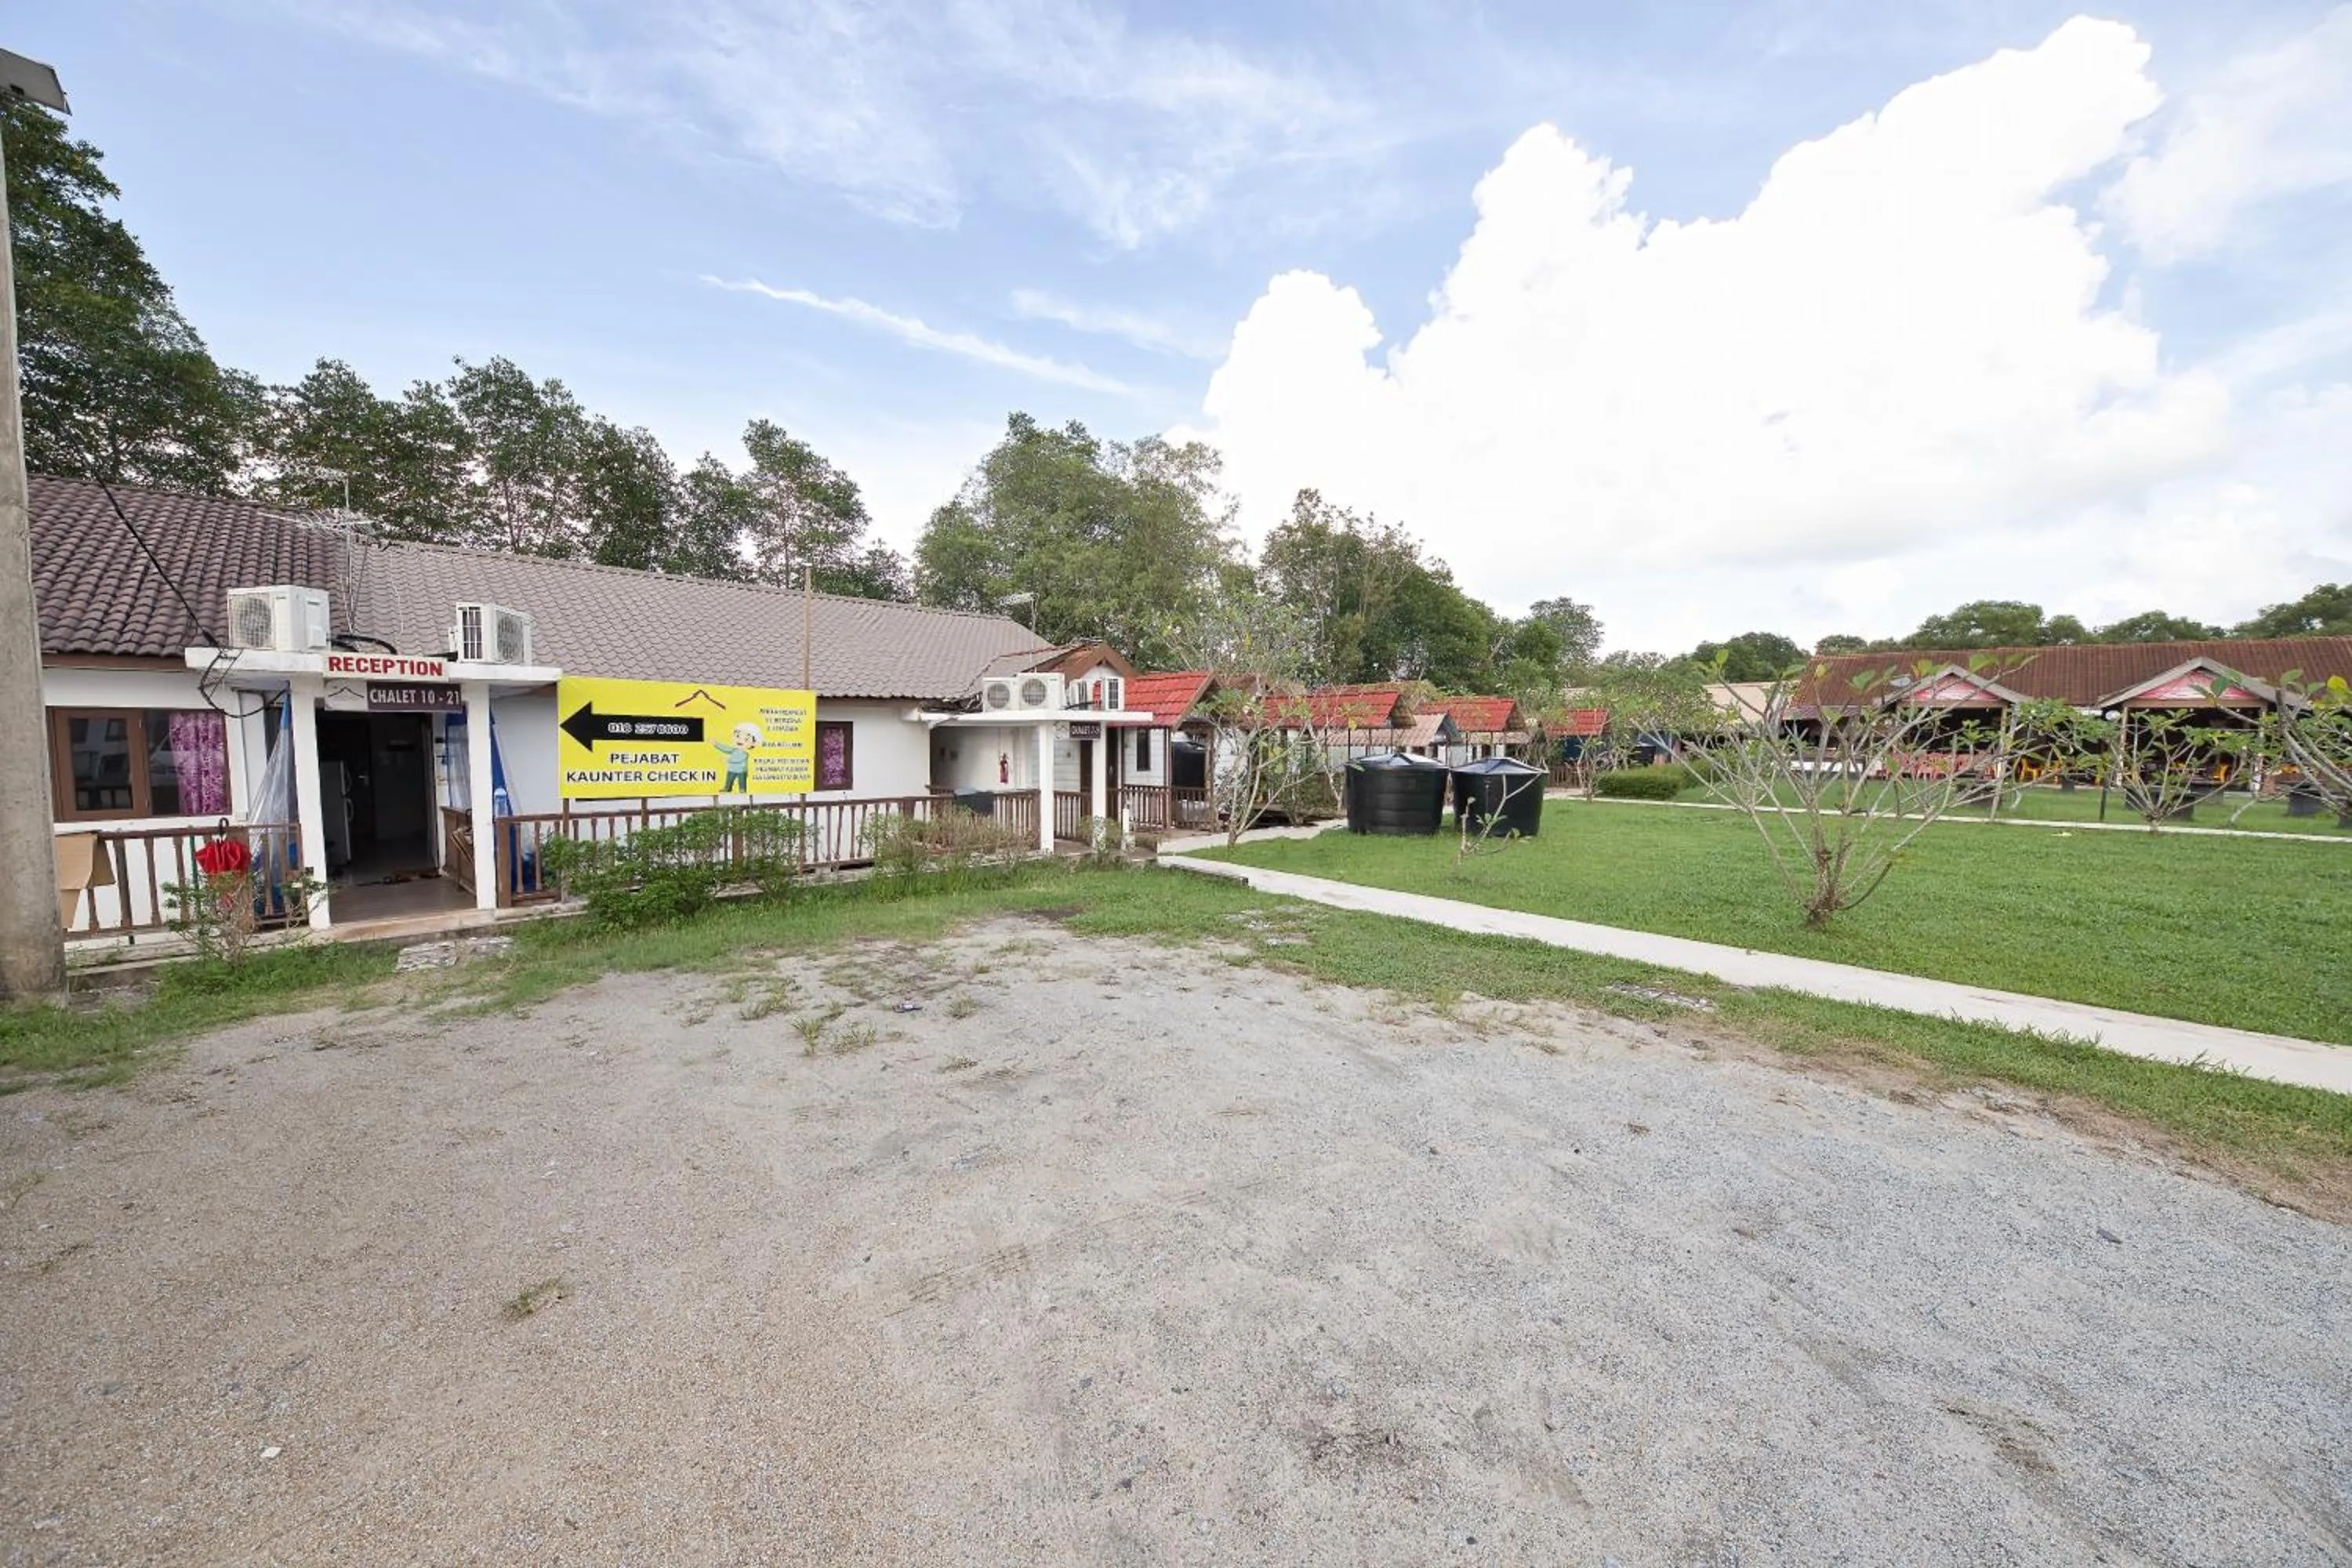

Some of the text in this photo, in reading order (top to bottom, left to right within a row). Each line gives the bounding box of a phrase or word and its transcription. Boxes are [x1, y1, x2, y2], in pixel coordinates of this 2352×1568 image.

[328, 656, 443, 677] RECEPTION
[369, 688, 416, 704] CHALET
[421, 690, 435, 704] 10
[446, 691, 460, 705] 21
[610, 753, 680, 764] PEJABAT
[567, 771, 717, 782] KAUNTER CHECK IN
